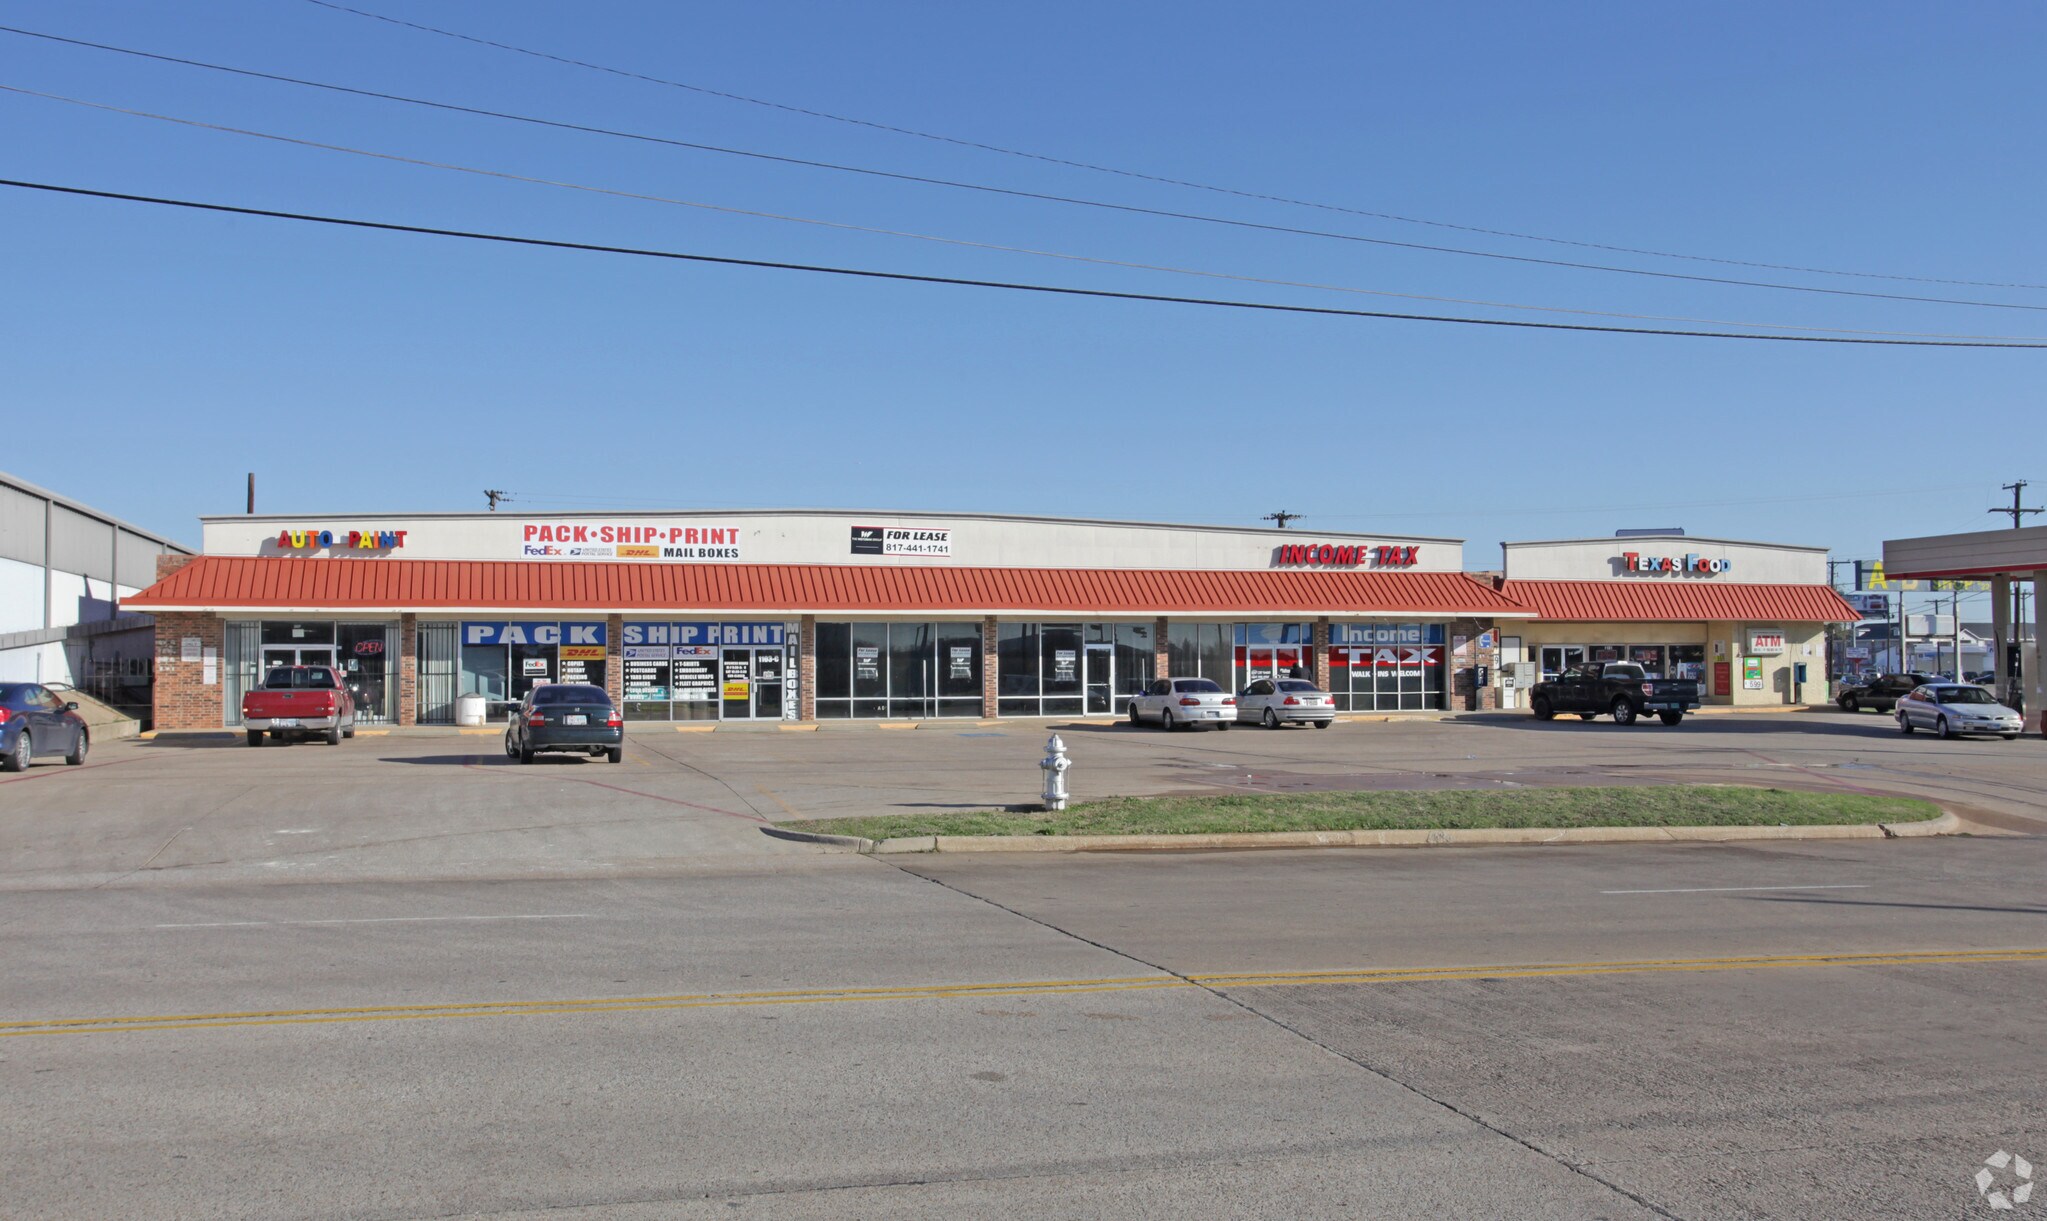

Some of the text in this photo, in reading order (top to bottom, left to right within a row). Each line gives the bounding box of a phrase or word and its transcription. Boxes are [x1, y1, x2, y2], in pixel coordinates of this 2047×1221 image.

[277, 530, 407, 549] AUTO PAINT
[524, 525, 739, 545] PACK SHIP PRINT
[886, 530, 948, 541] FOR LEASE
[524, 545, 562, 556] FedEx
[663, 547, 739, 558] MAIL BOXES
[886, 543, 948, 553] 817-441-1741
[1279, 543, 1420, 565] INCOME TAX
[1623, 552, 1732, 573] TEXAS FOOD
[467, 625, 599, 644] PACK
[623, 625, 783, 644] SHIP PRINT
[1342, 624, 1419, 642] Income
[354, 641, 384, 653] OPEN
[1755, 634, 1781, 647] ATM
[566, 649, 600, 657] DHL
[676, 646, 711, 655] FedEx
[1338, 648, 1439, 664] TAX
[525, 660, 544, 668] FedEx
[786, 622, 799, 719] MAIL BOXES
[1351, 670, 1371, 678] WALK
